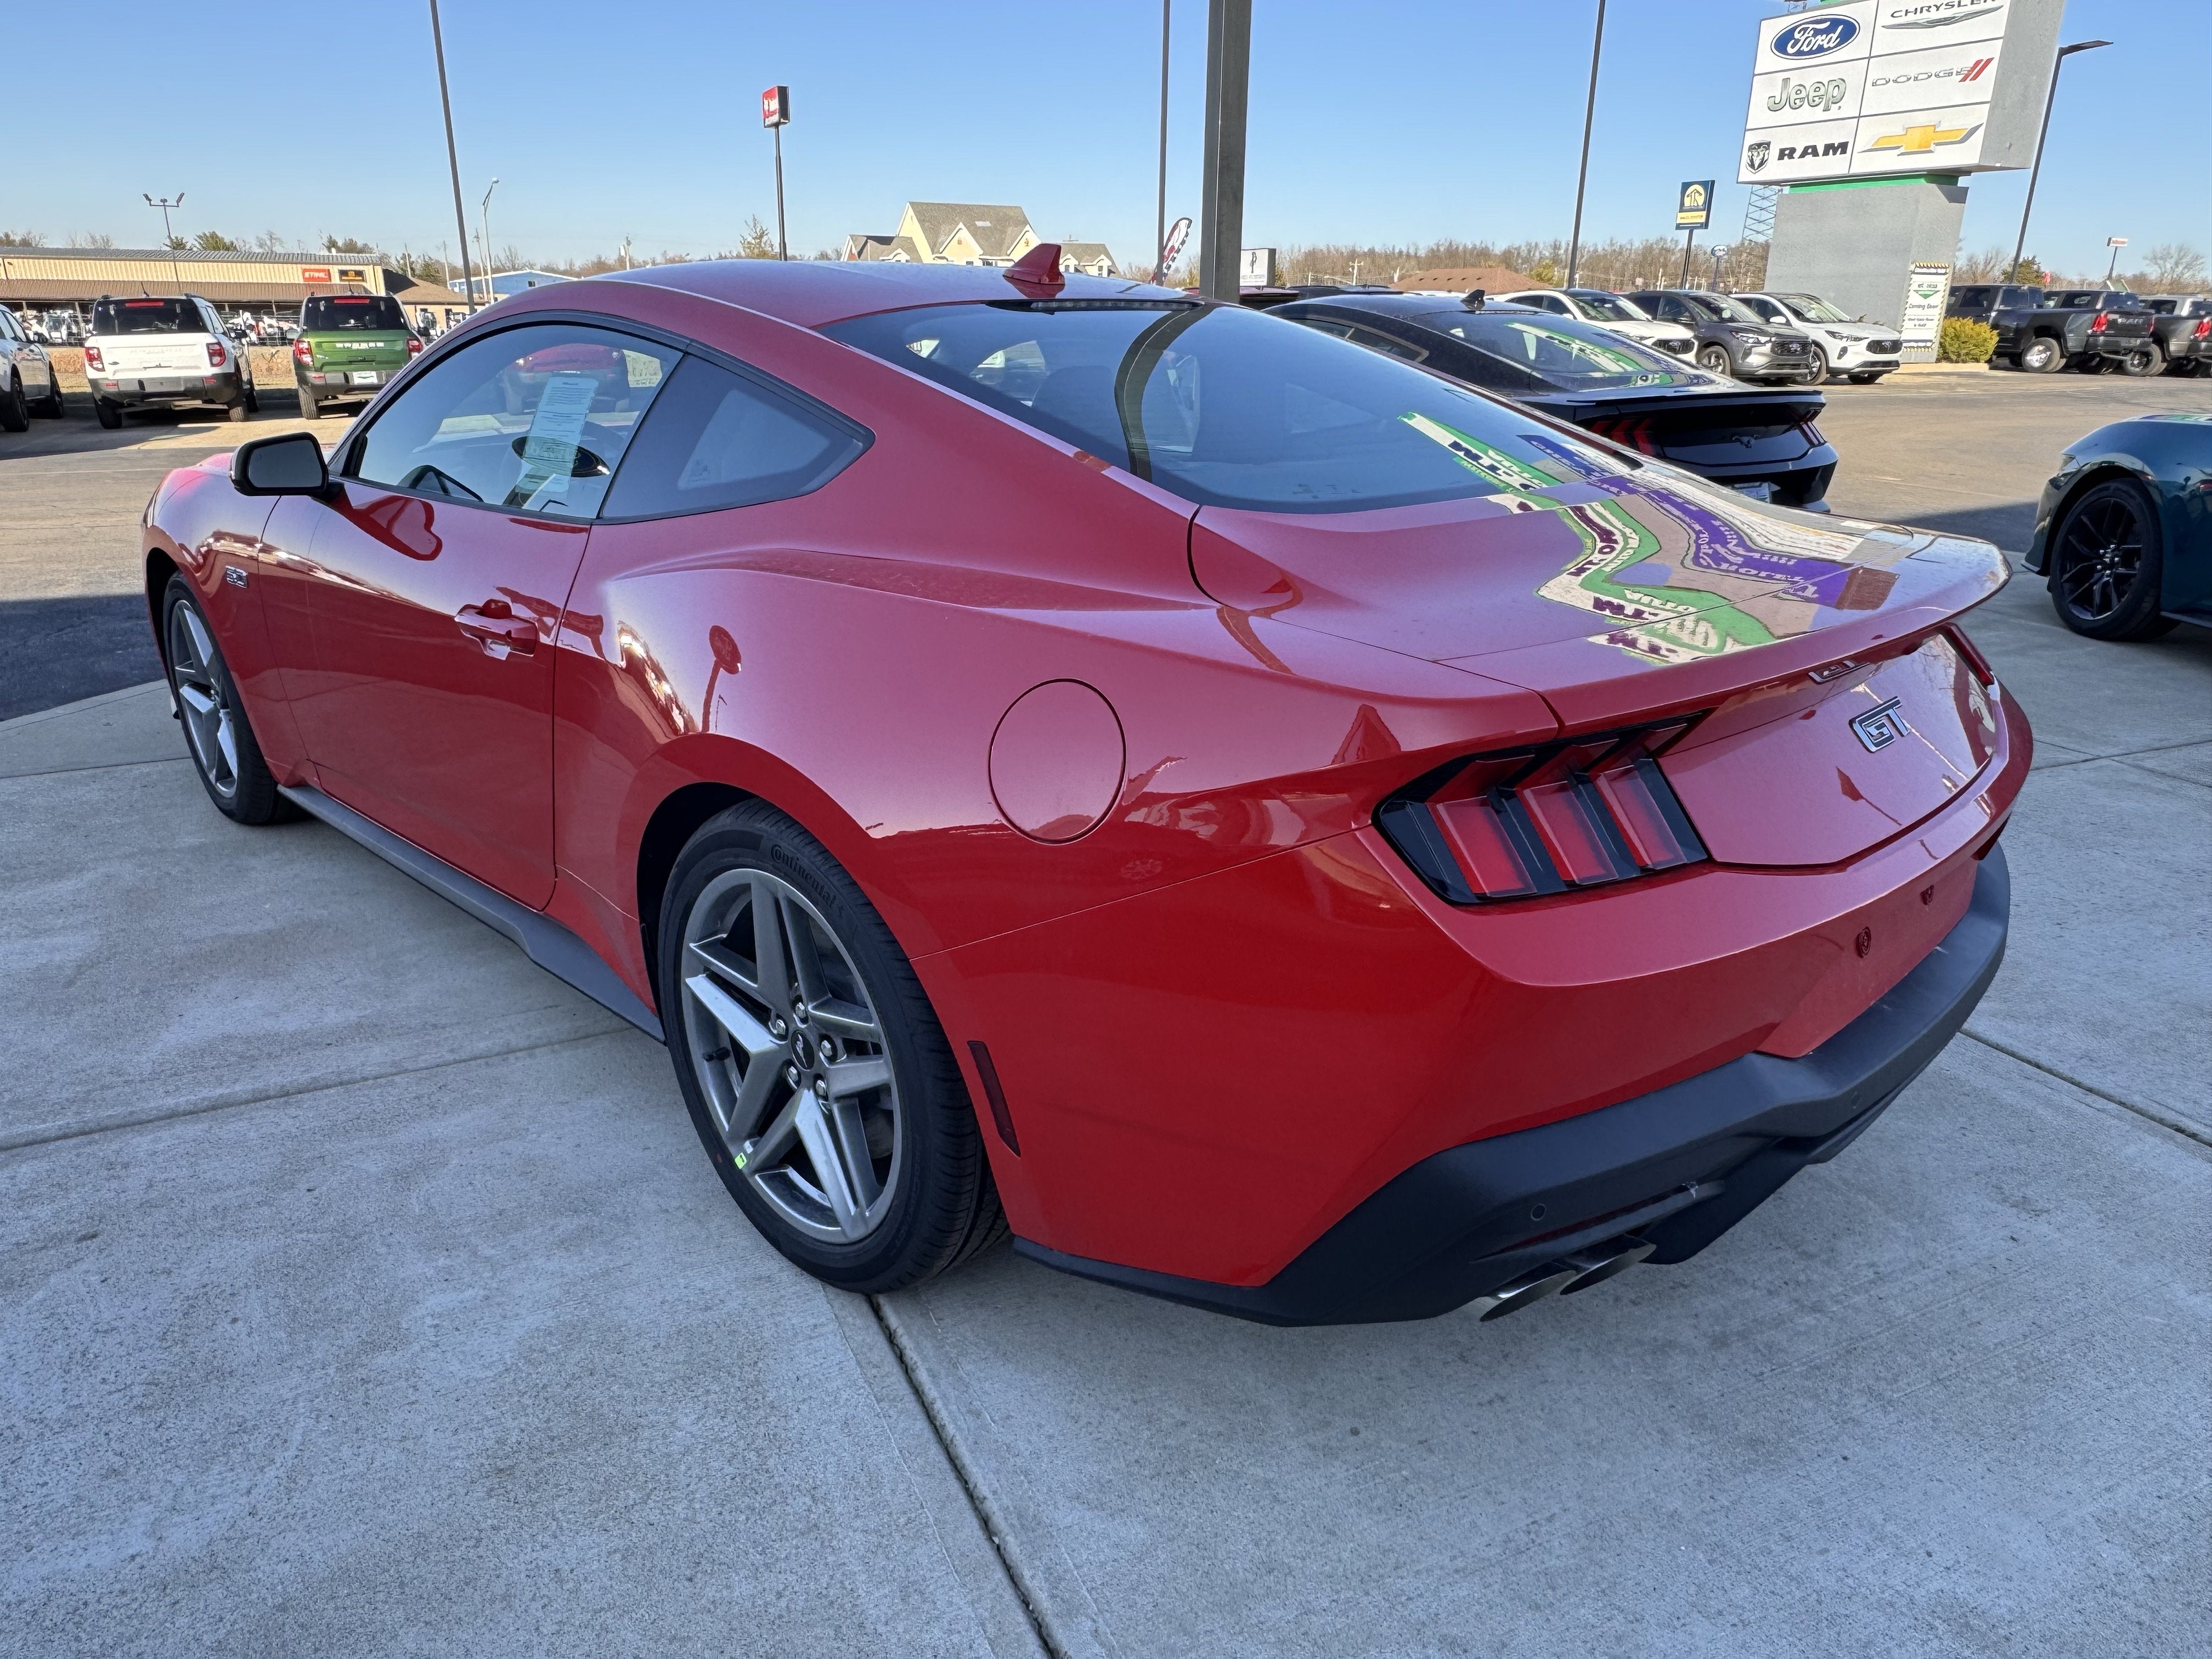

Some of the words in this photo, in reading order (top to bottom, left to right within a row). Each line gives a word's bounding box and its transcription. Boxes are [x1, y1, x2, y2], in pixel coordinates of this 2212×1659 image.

[1891, 0, 1996, 18] CHRYSLE
[1786, 21, 1844, 54] Ford
[1872, 66, 1972, 87] DODGE
[1767, 77, 1847, 112] Jeep
[1777, 141, 1849, 161] RAM
[1849, 695, 1910, 754] GT
[770, 844, 837, 908] Continental
